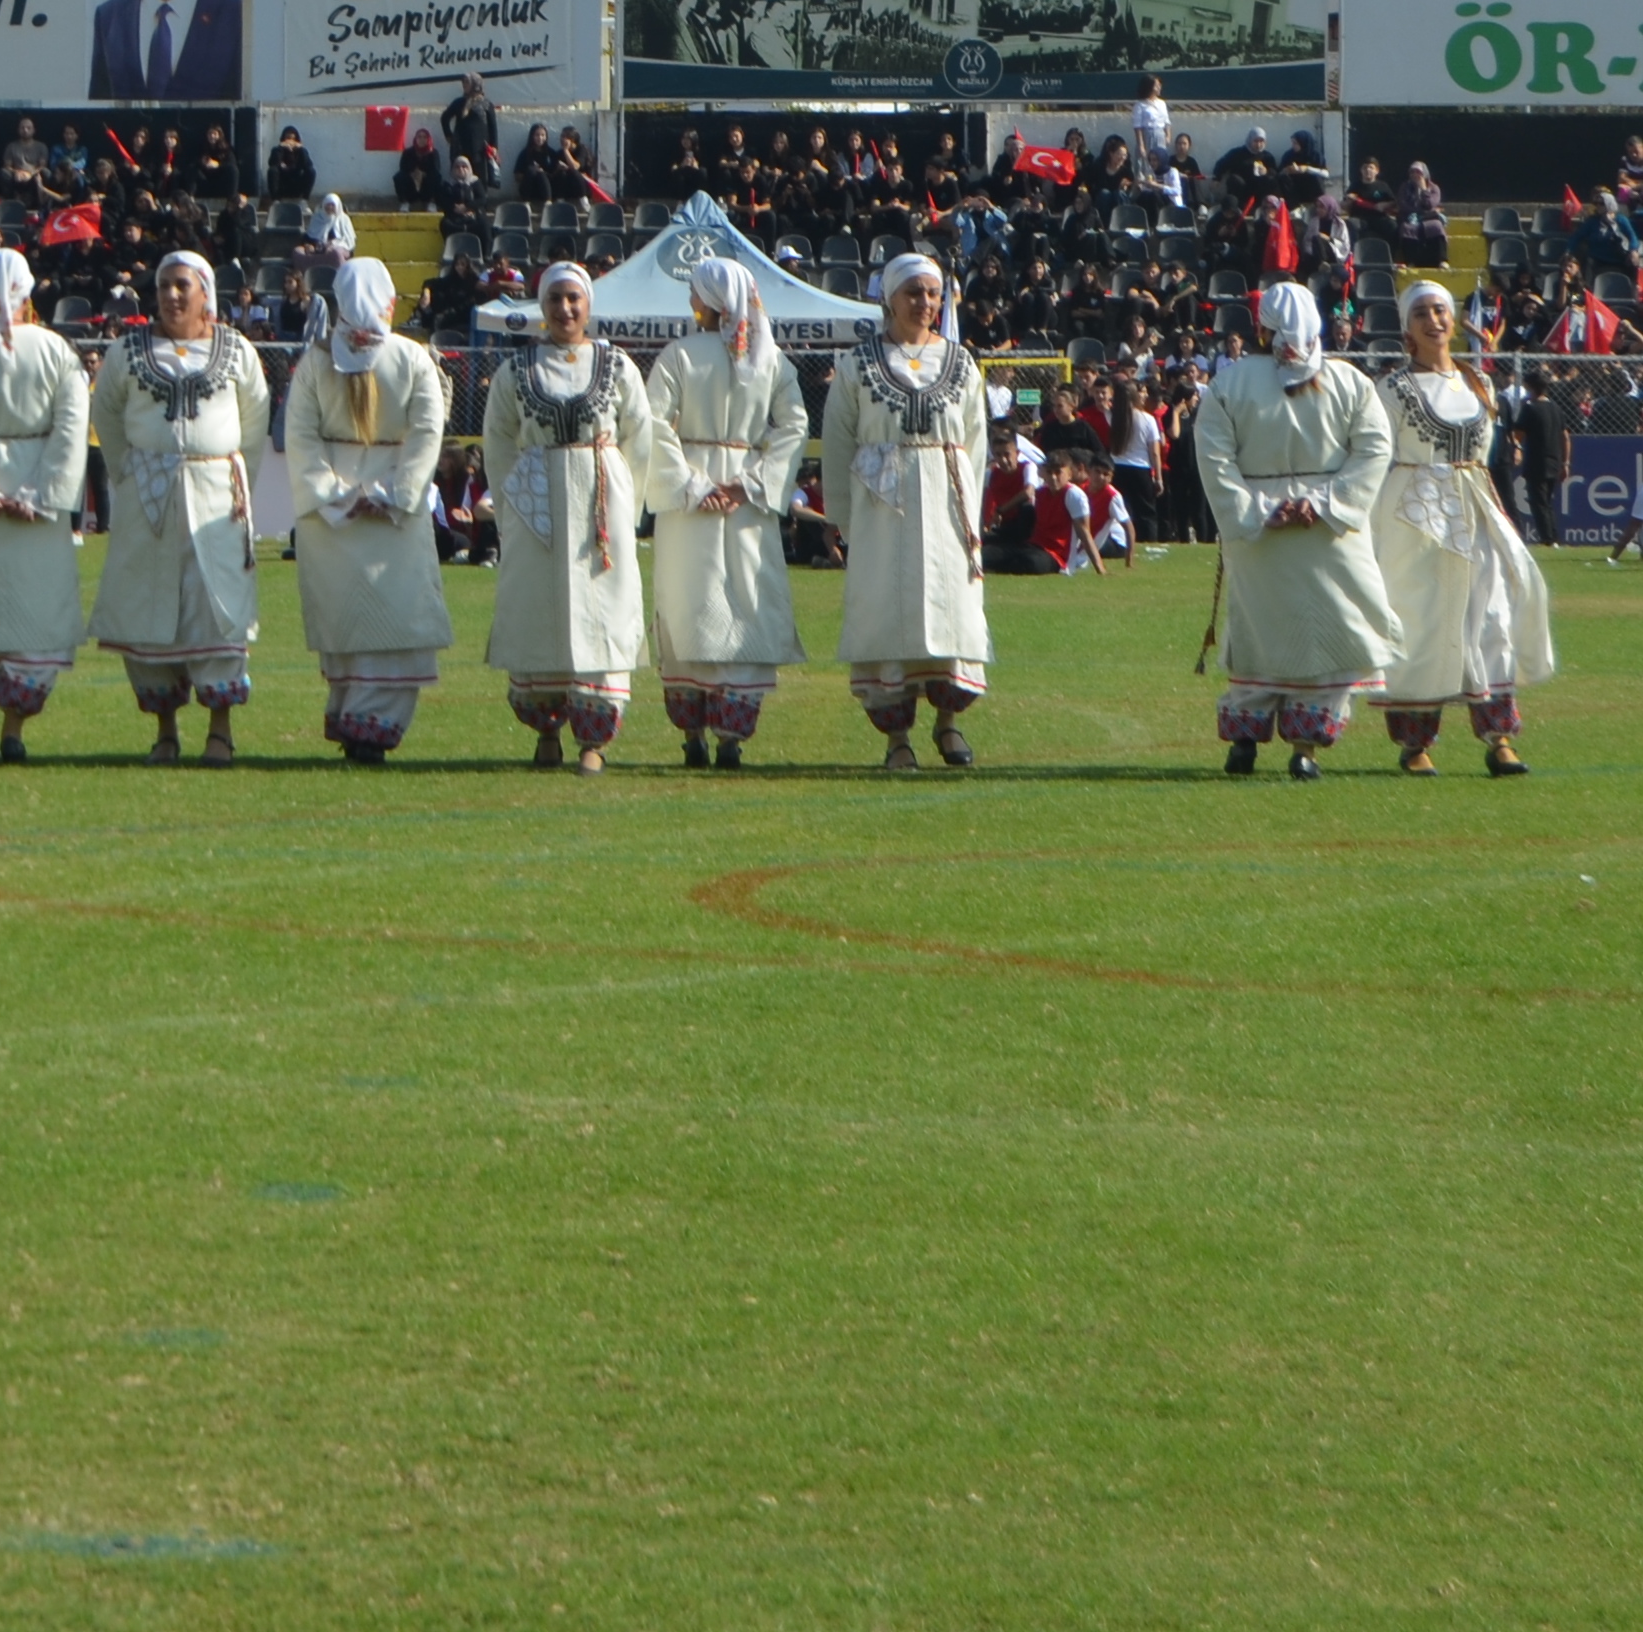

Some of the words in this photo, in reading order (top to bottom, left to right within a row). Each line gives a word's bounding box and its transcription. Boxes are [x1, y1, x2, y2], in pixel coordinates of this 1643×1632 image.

[308, 55, 336, 78] Bu
[344, 51, 411, 79] Şehrin
[418, 39, 503, 70] Ruhunda
[511, 34, 550, 58] var!
[1444, 1, 1643, 96] ÖR-
[900, 76, 933, 87] ÖZCAN
[597, 319, 688, 338] NAZİLLİ
